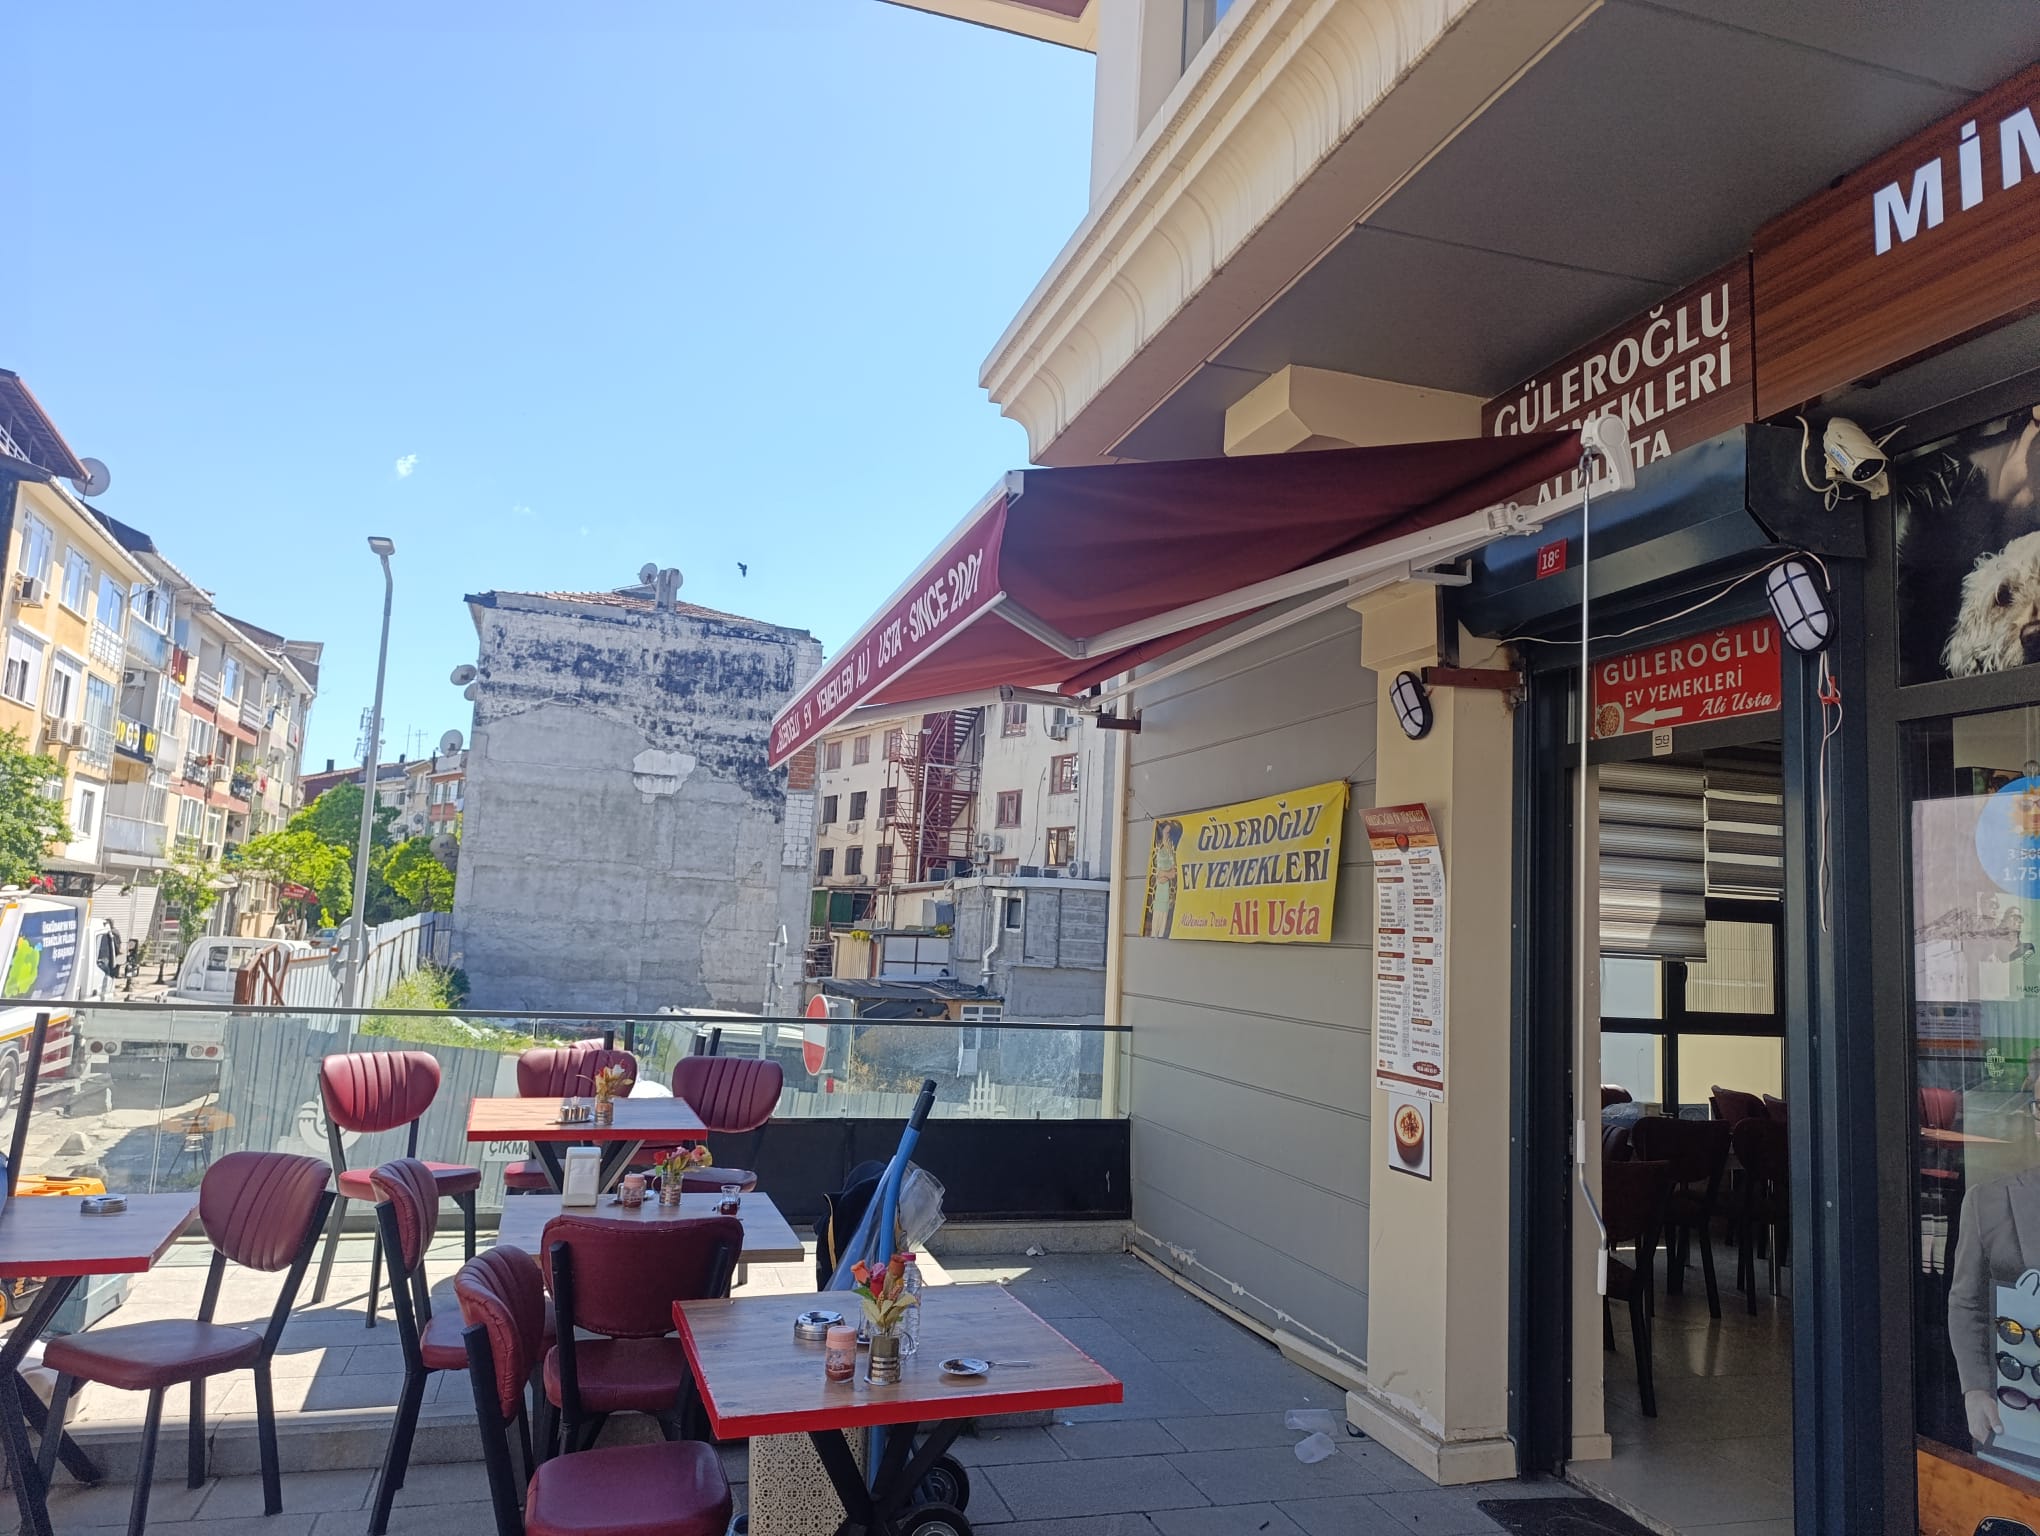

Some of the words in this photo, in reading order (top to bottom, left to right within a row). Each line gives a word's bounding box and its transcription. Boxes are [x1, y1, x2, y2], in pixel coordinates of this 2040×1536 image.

[1494, 284, 1730, 437] GÜLEROĞLU
[803, 699, 812, 730] EV
[816, 654, 855, 719] YEMEKLERİ
[856, 639, 870, 689] ALİ
[878, 618, 902, 668] USTA
[909, 577, 949, 642] SINCE
[1603, 627, 1770, 686] GÜLEROĞLU
[1625, 689, 1644, 708] EV
[1648, 664, 1743, 703] YEMEKLERİ
[1699, 699, 1727, 718] Ali
[1728, 691, 1774, 713] Usta
[1197, 801, 1323, 852] GÜLEROĞLU
[1181, 863, 1204, 891] EV
[1205, 837, 1331, 889] YEMEKLERİ
[1229, 901, 1260, 936] Ali
[1267, 899, 1321, 936] Usta
